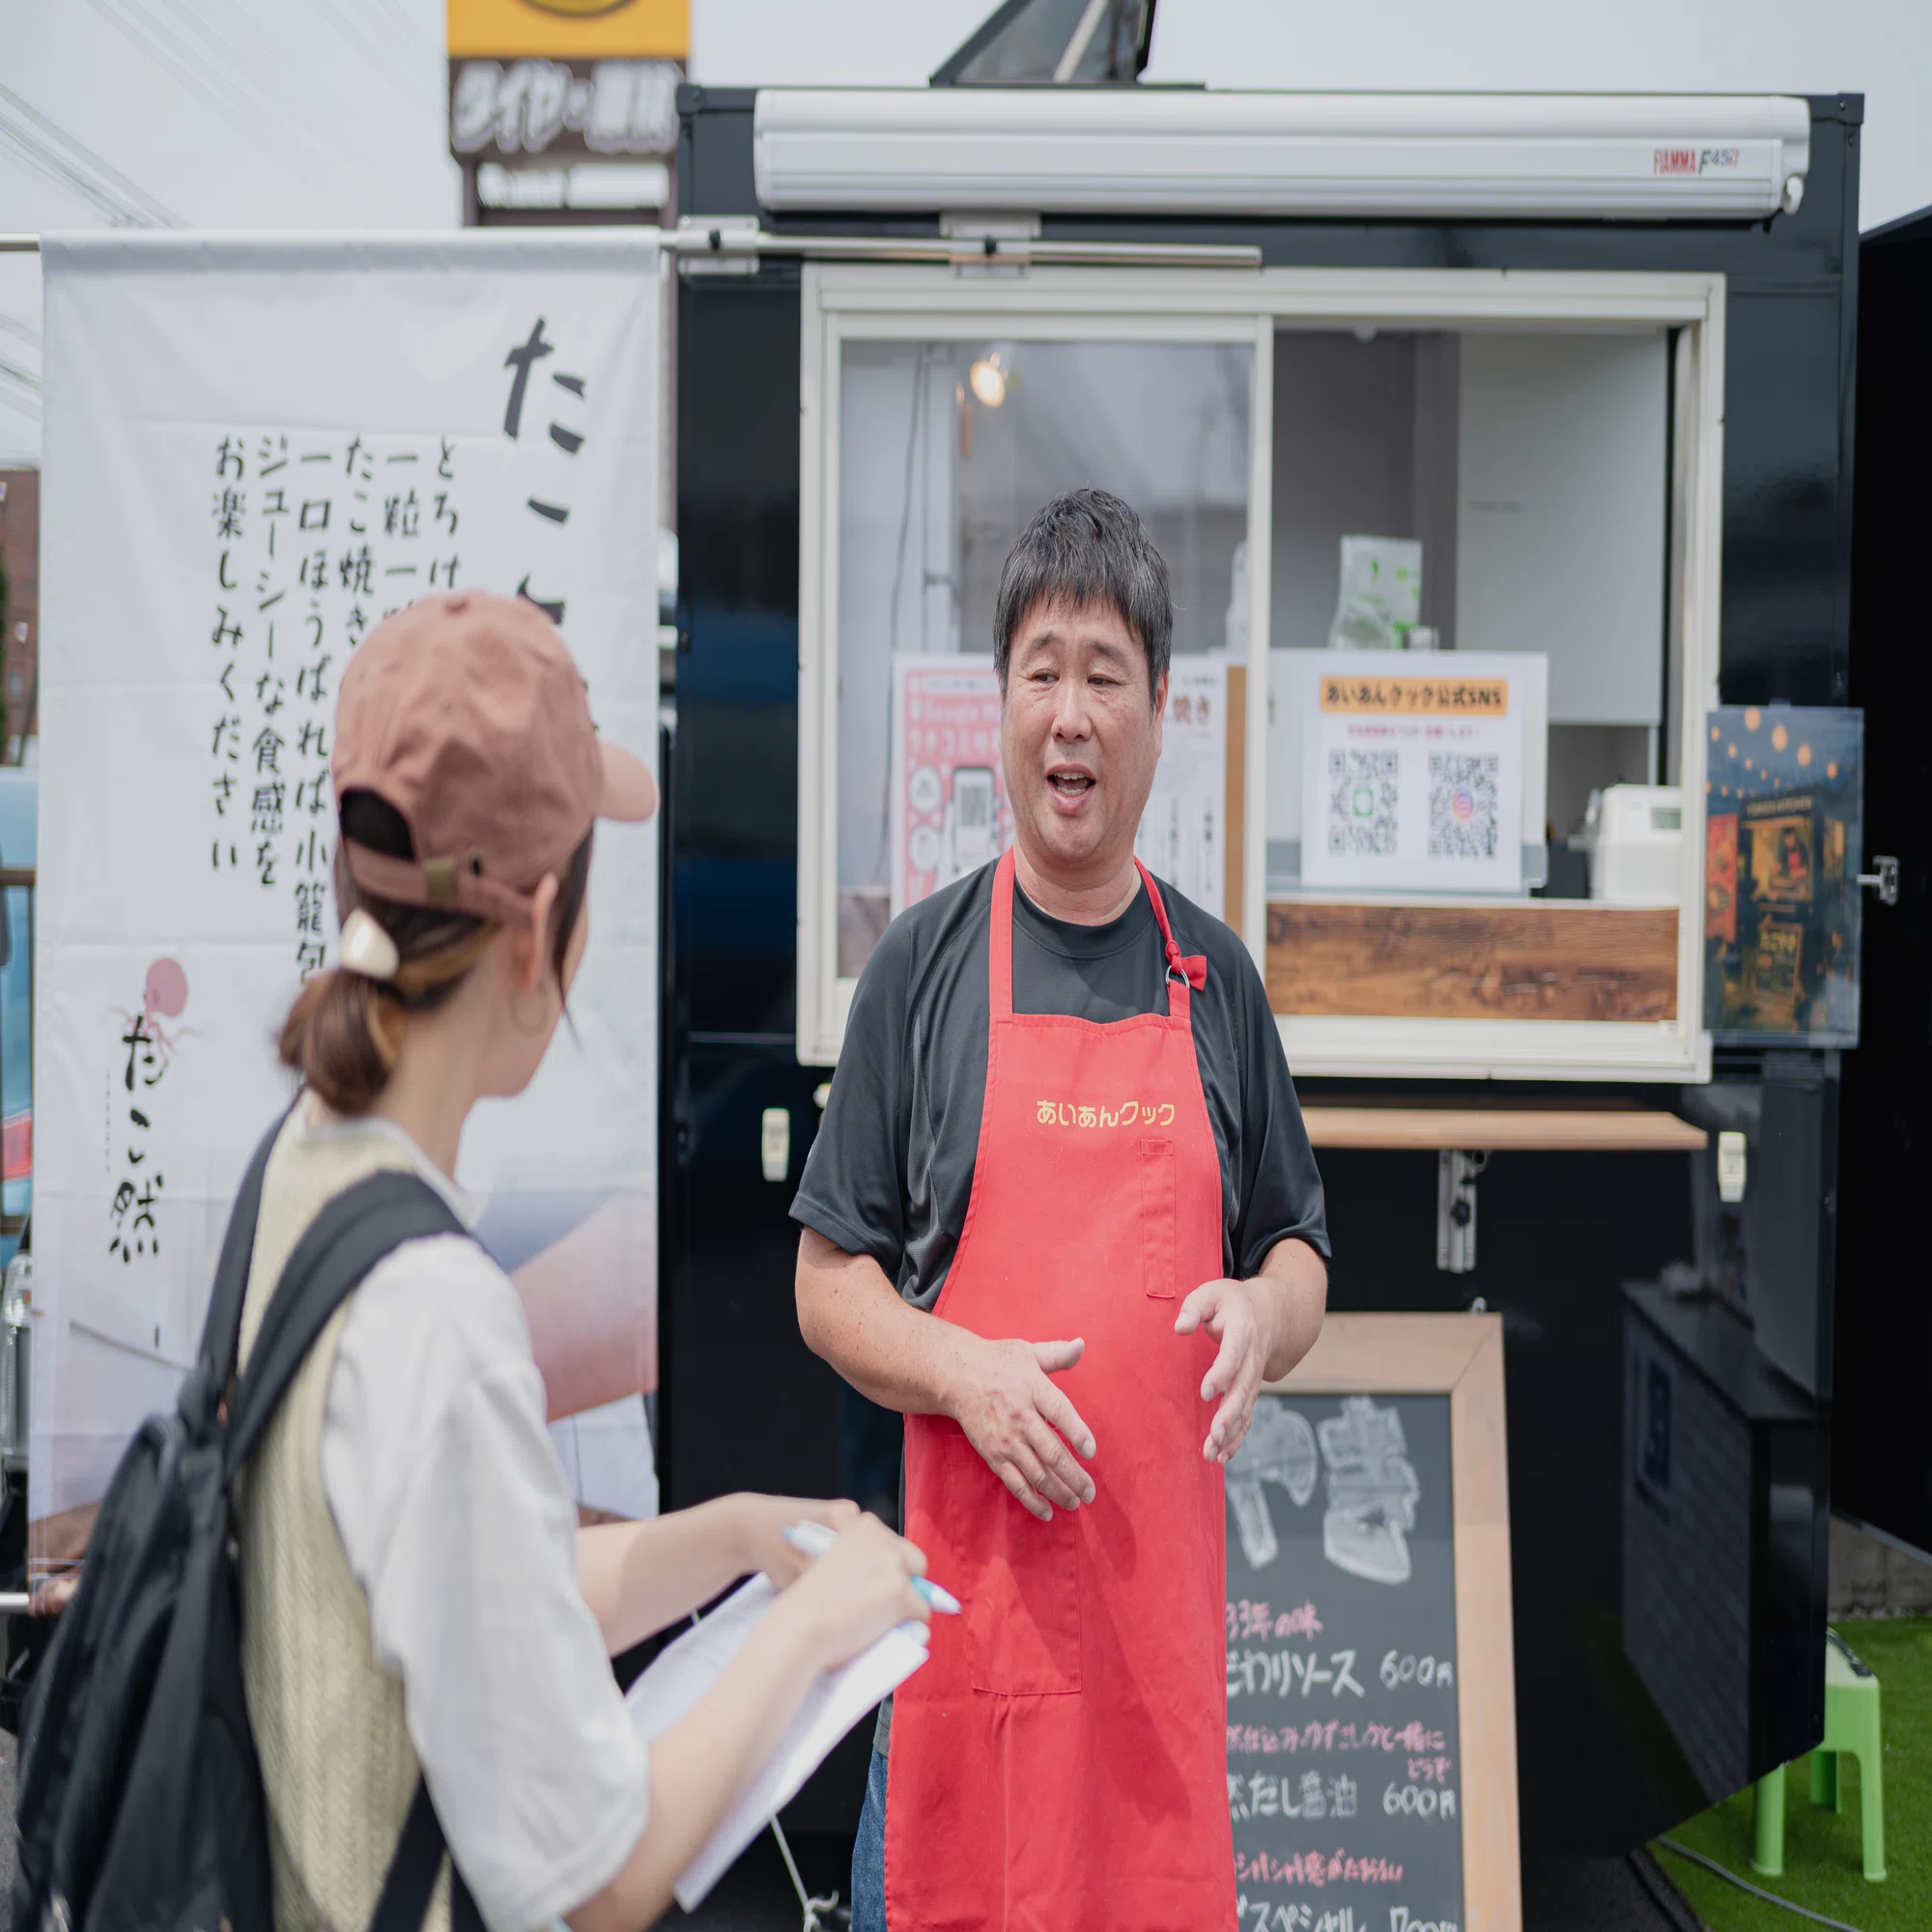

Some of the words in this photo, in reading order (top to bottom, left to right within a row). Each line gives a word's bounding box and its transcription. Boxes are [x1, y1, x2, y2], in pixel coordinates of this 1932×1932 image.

[1653, 148, 1696, 175] FIAMMA
[338, 435, 375, 646] たこ焼き
[384, 454, 419, 620] 一粒一
[503, 316, 586, 628] たこ
[212, 435, 246, 868] お楽しみください
[251, 433, 290, 886] ジューシーな食感を
[1037, 1099, 1176, 1128] あいあんクック
[1379, 1648, 1455, 1690] 600円
[1382, 1779, 1458, 1821] 600円
